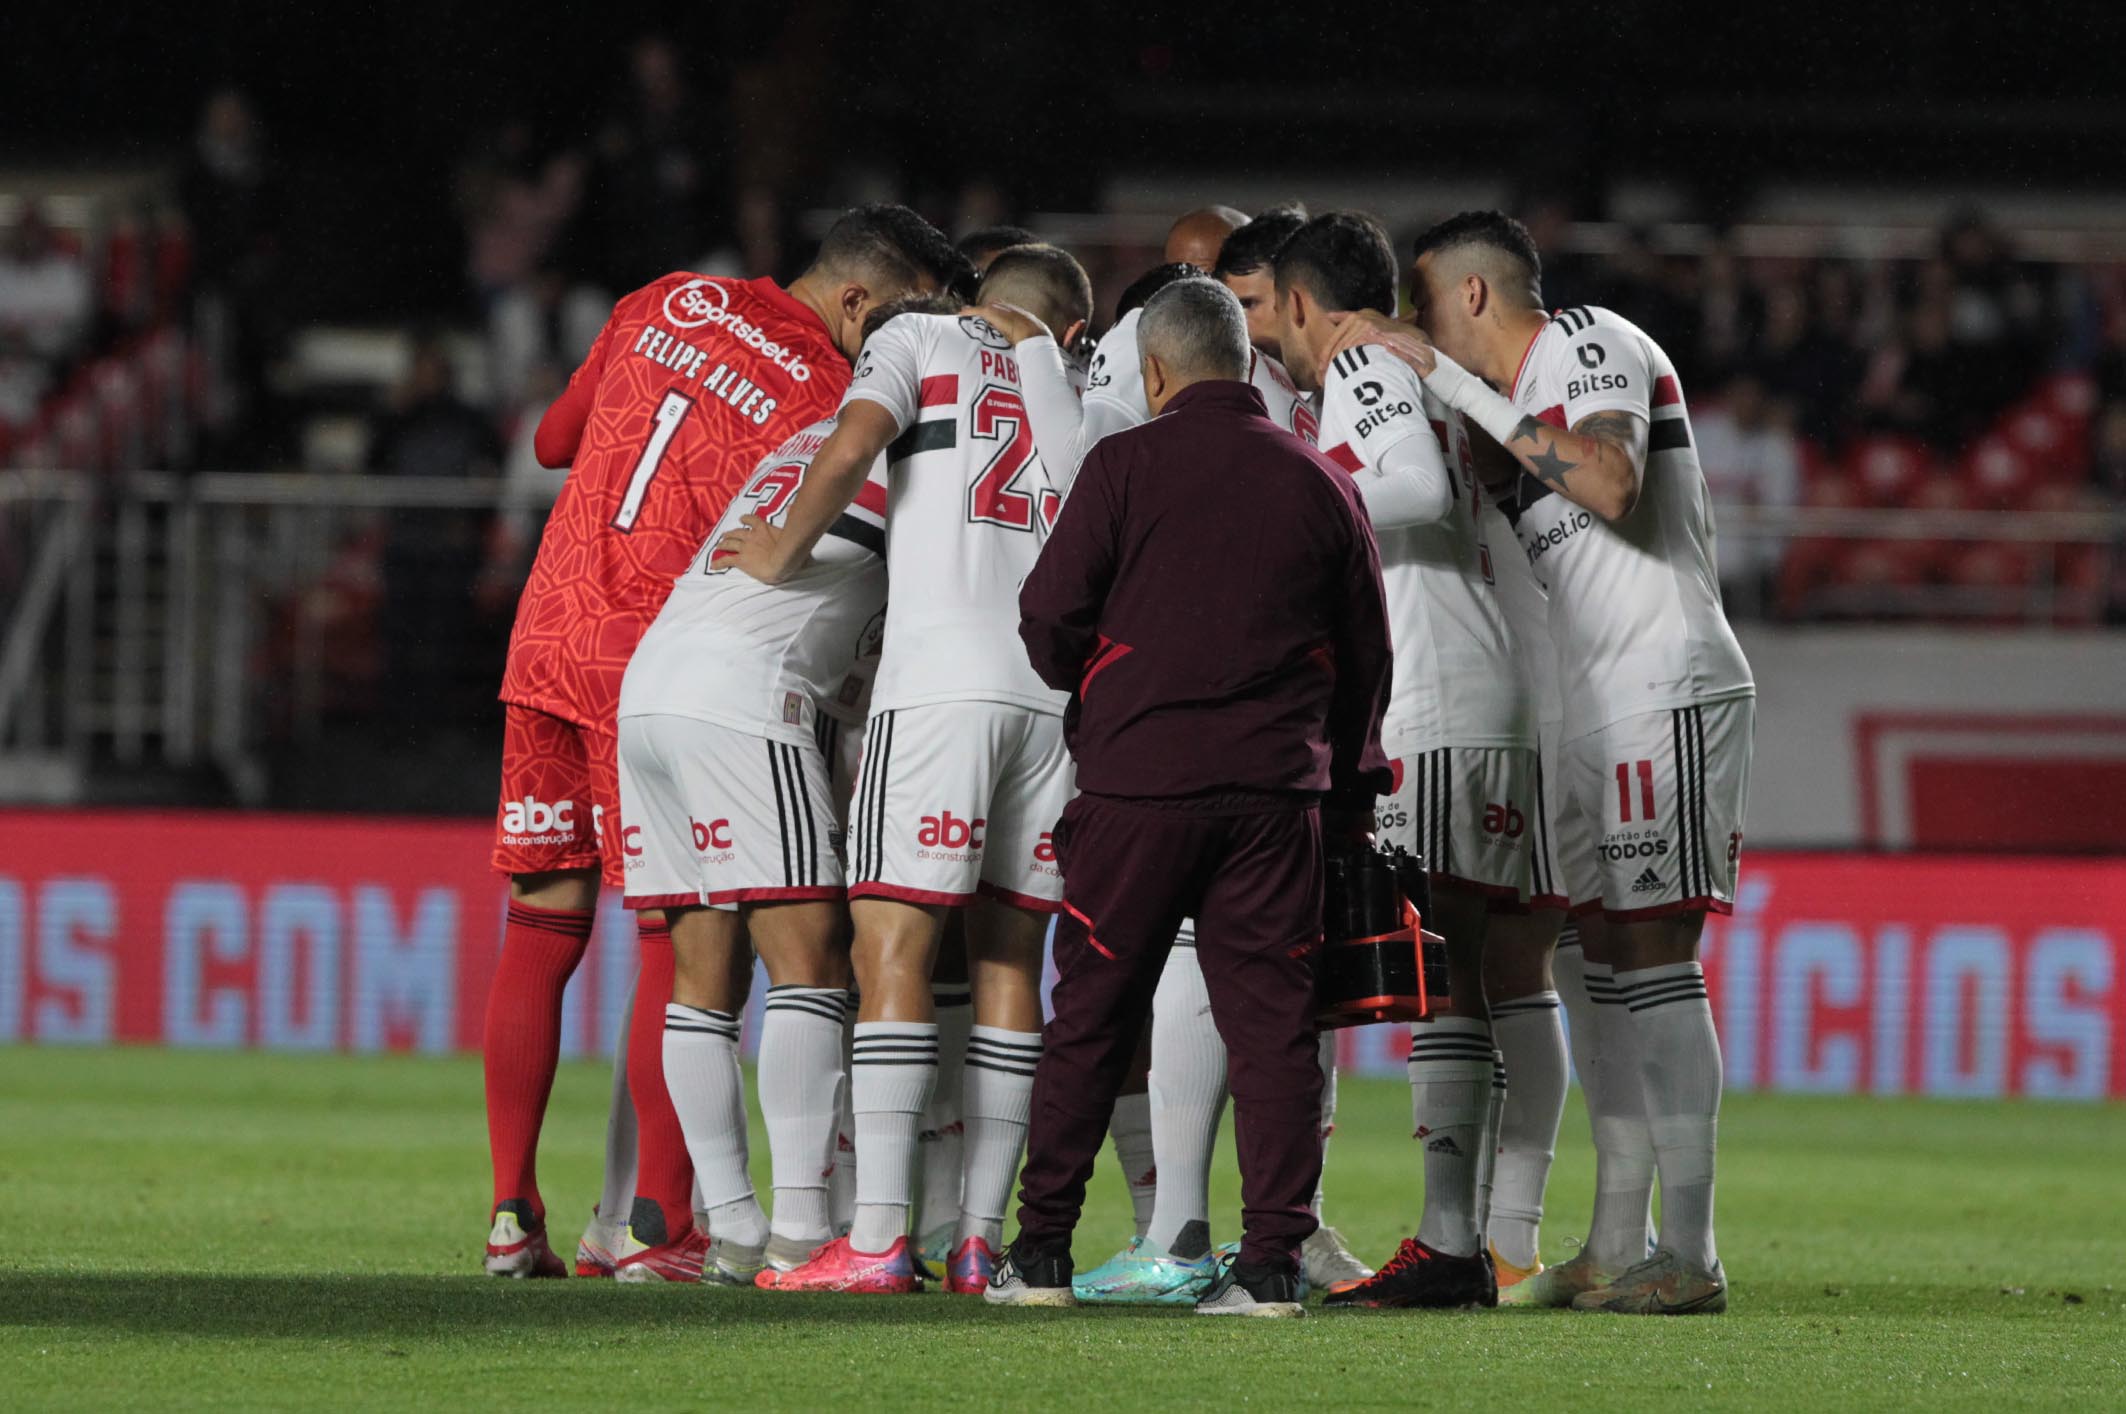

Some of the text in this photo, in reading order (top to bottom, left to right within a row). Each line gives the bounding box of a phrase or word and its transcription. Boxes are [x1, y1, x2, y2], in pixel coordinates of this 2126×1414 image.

[634, 326, 777, 425] FELIPE ALVES
[980, 350, 1022, 388] PAB
[1568, 373, 1628, 401] Bitso
[1355, 401, 1412, 439] Bitso
[611, 387, 696, 535] 1
[1616, 760, 1656, 823] 11
[503, 795, 574, 834] abc
[689, 815, 732, 852] bc
[918, 811, 986, 849] abc
[1482, 800, 1525, 838] ab
[1644, 829, 1659, 838] de
[503, 832, 575, 846] da construção
[917, 850, 930, 858] da
[1598, 839, 1668, 861] TODOS
[1632, 881, 1667, 893] adidas
[163, 880, 458, 1053] COM
[1700, 872, 2115, 1097] ÍCIOS
